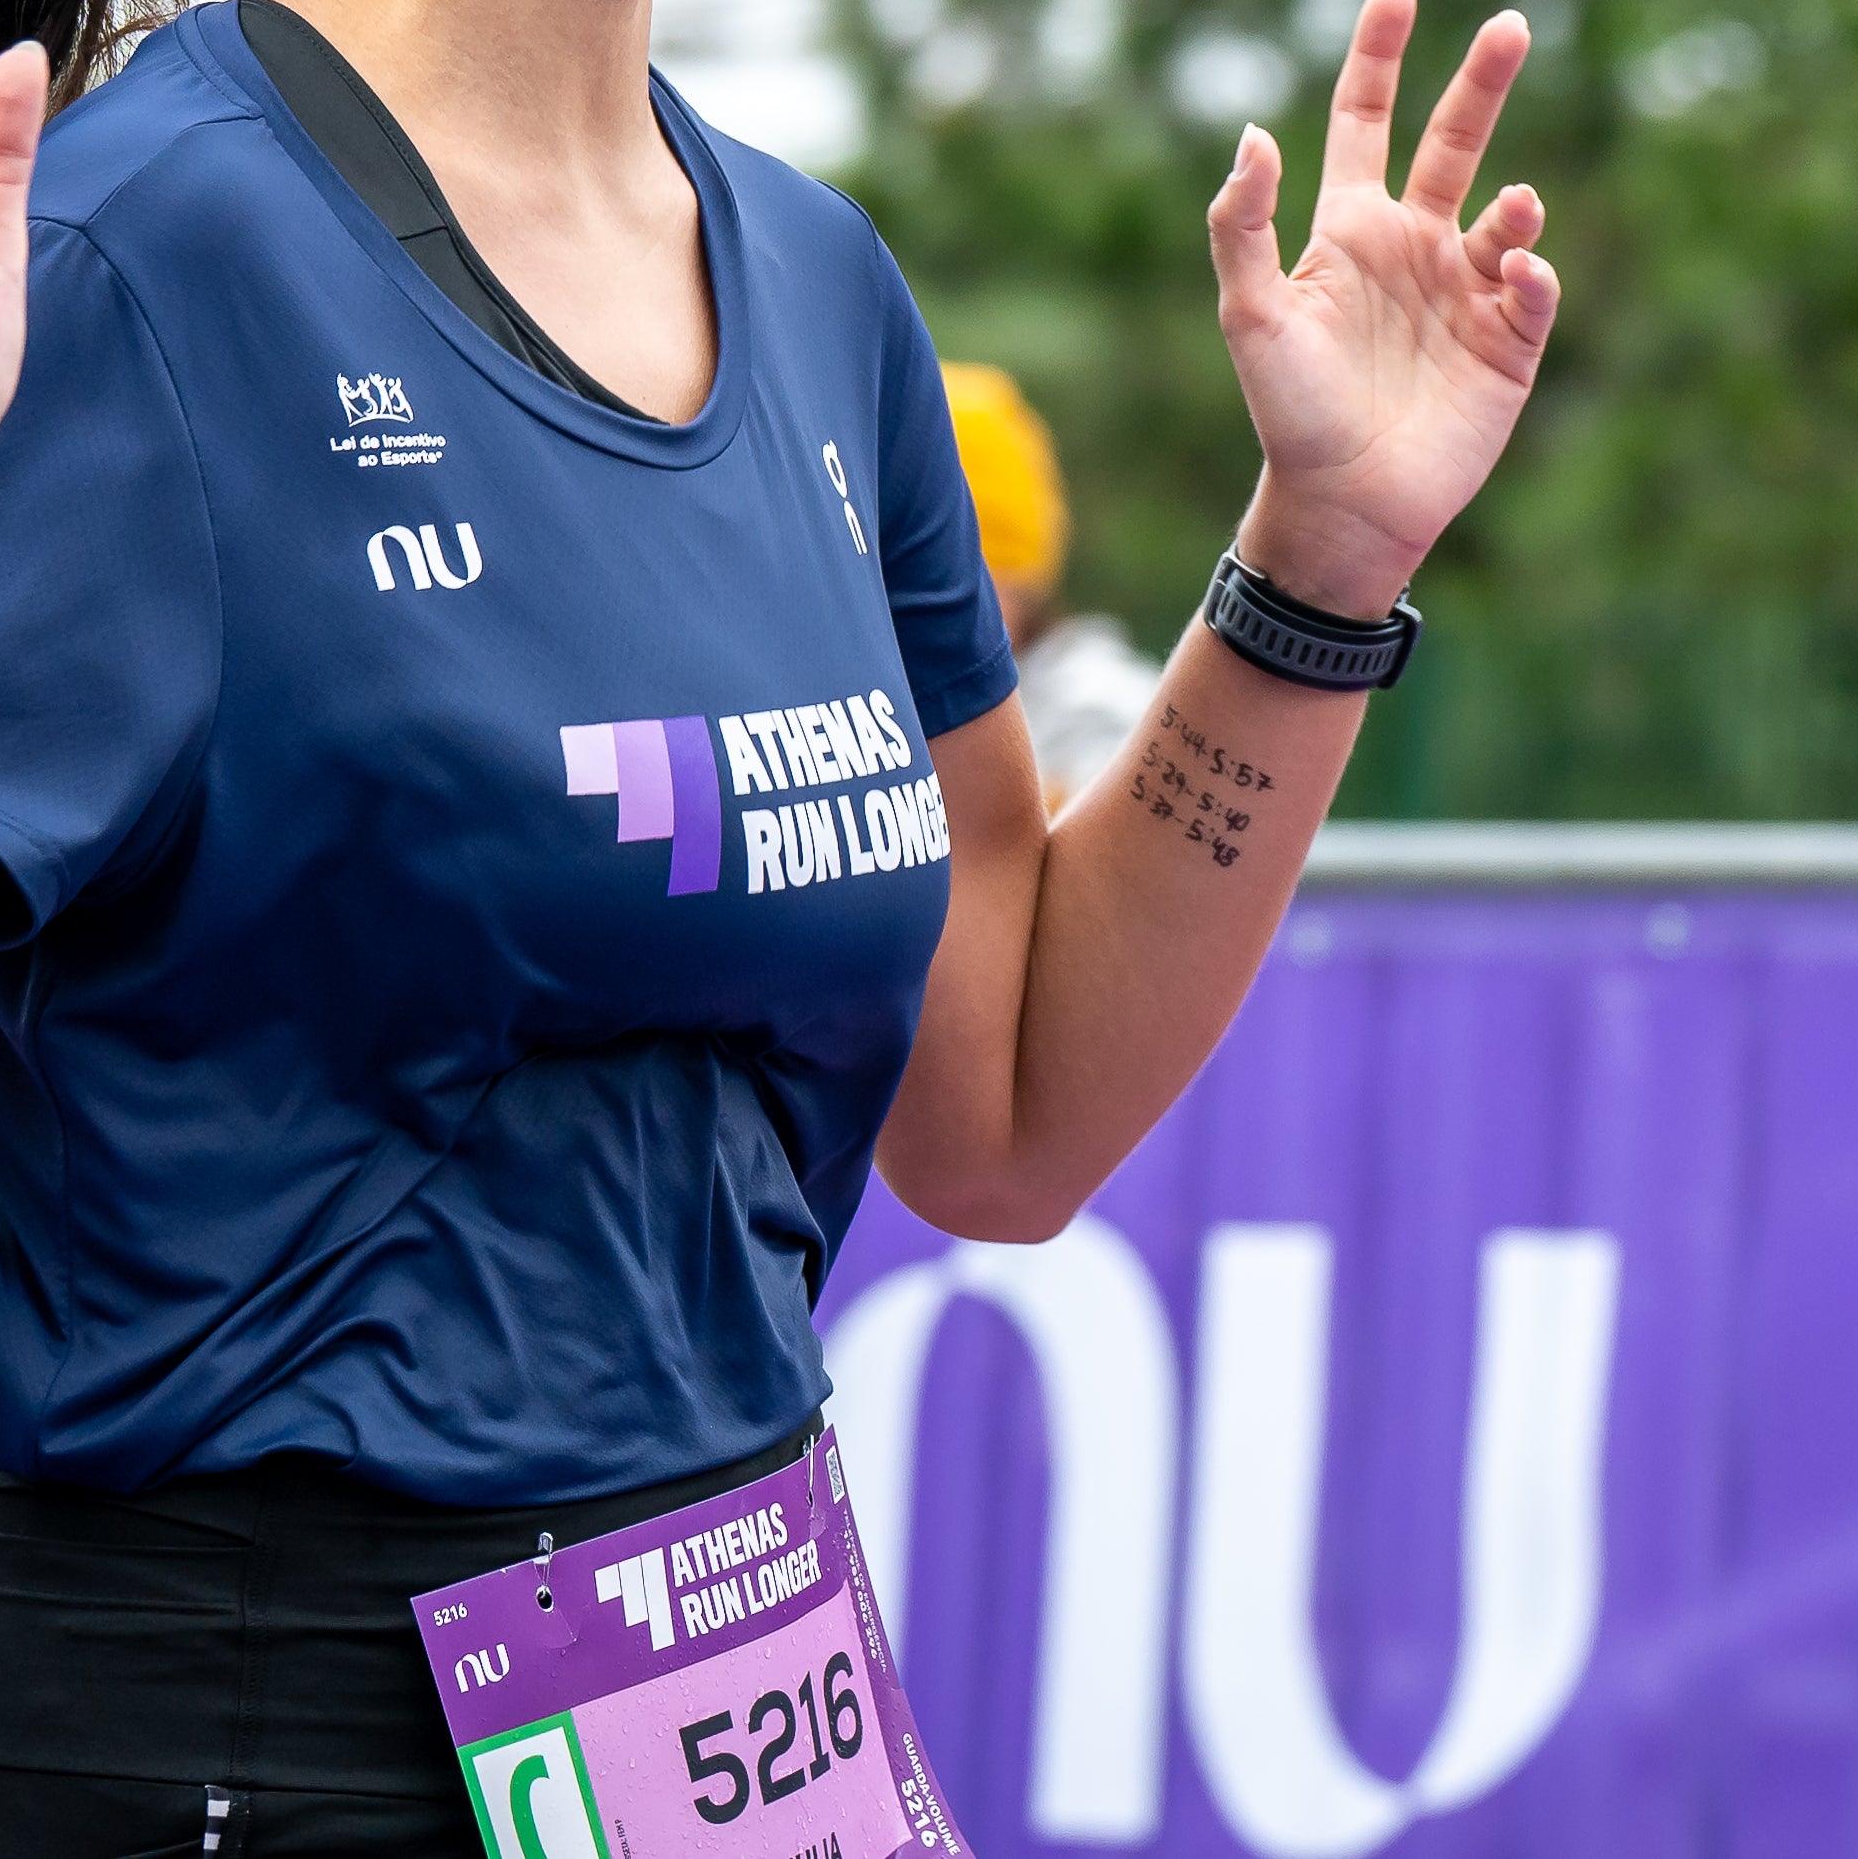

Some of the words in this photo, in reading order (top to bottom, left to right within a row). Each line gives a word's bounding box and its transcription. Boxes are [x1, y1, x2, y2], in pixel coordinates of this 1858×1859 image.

[330, 435, 357, 452] Lei
[360, 434, 380, 450] de
[382, 432, 447, 449] Incentivo
[358, 454, 378, 467] ao
[718, 688, 912, 796] ATHENAS
[741, 798, 842, 895] RUN
[836, 770, 951, 877] LONGE
[670, 1502, 789, 1588] ATHENAS
[433, 1602, 468, 1627] 5216
[679, 1577, 746, 1639] RUN
[742, 1539, 822, 1615] LONGER
[678, 1651, 863, 1824] 5216
[901, 1778, 939, 1848] 5216
